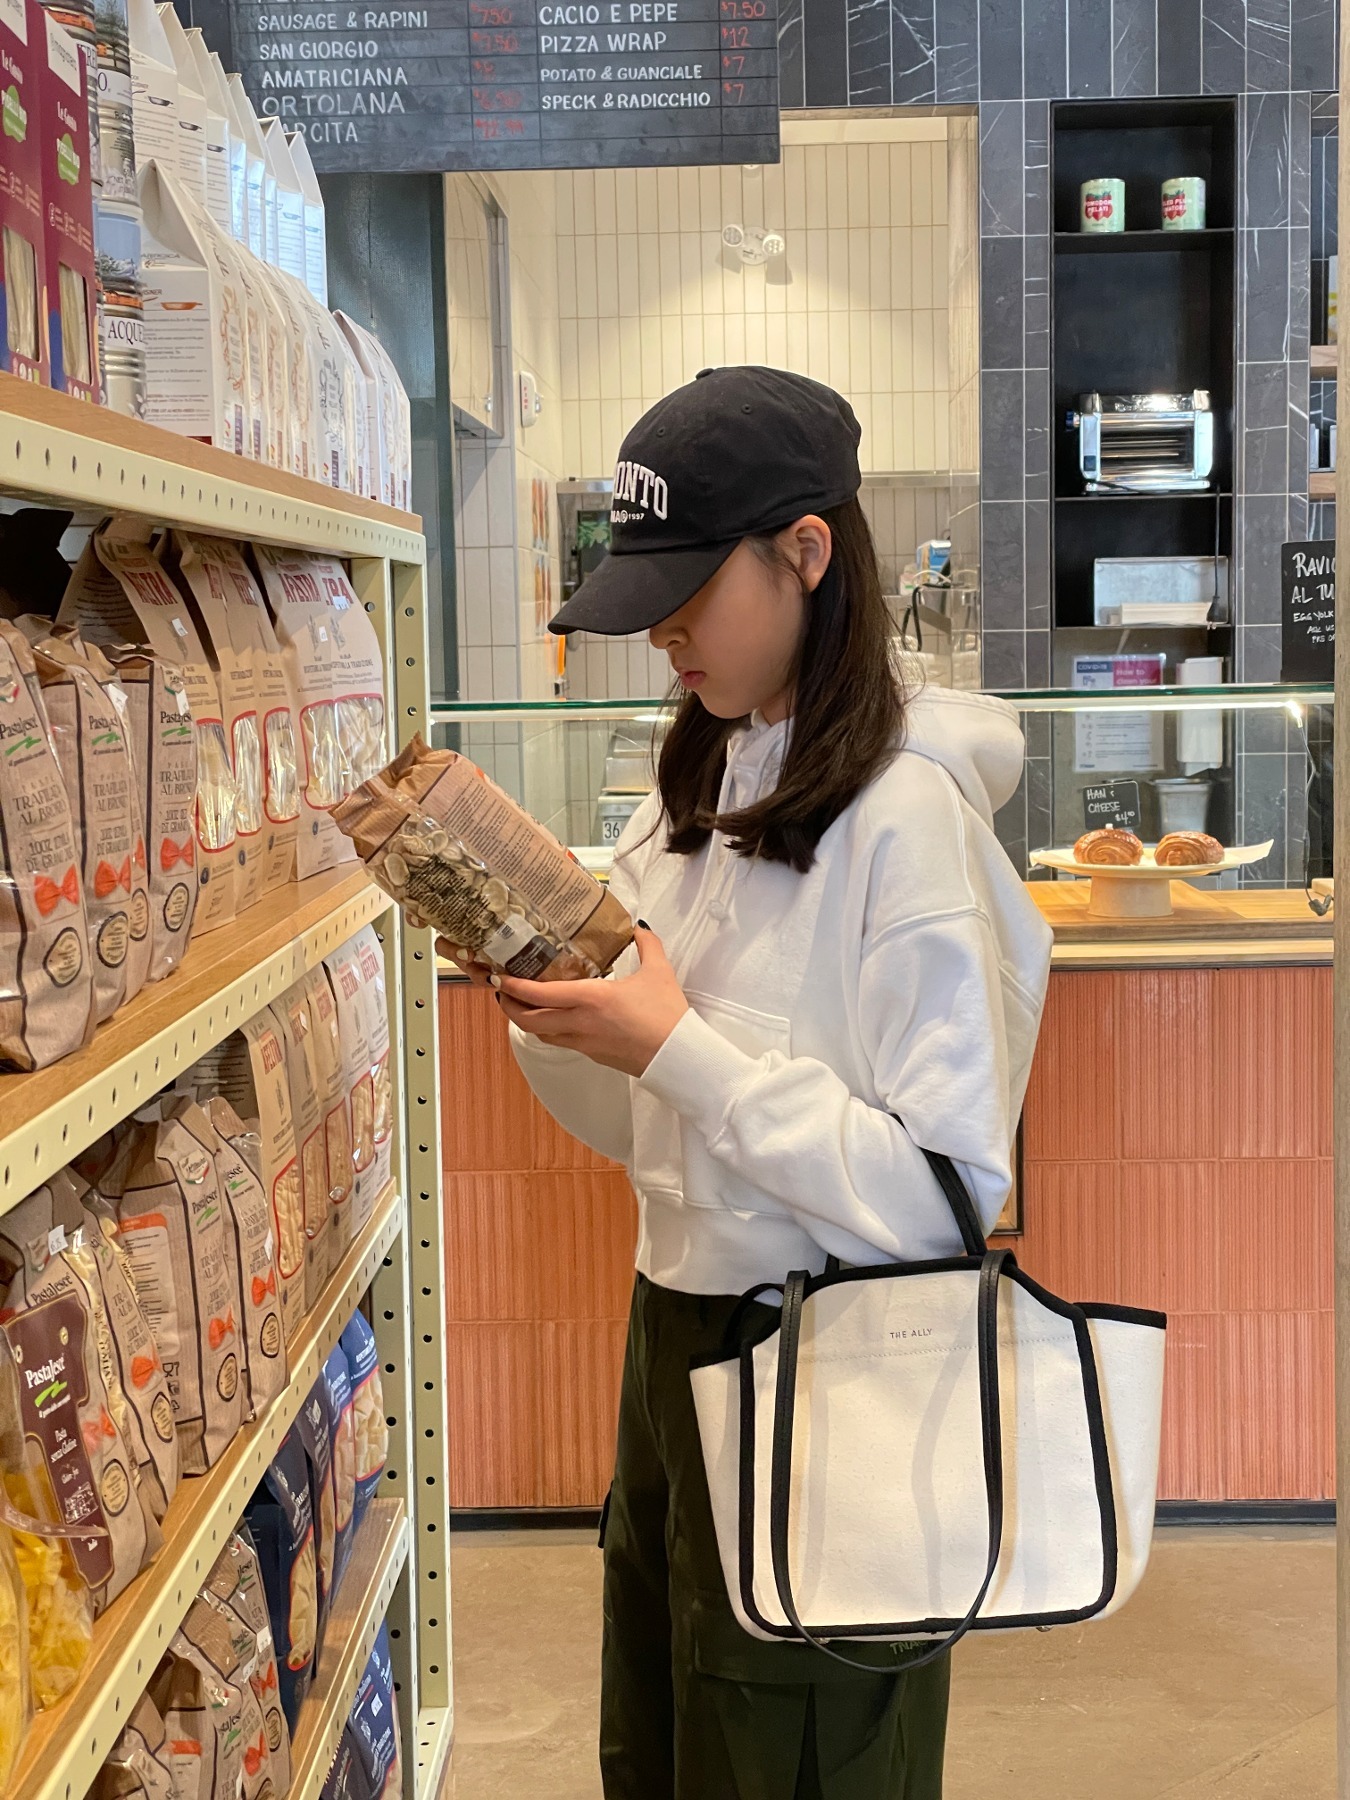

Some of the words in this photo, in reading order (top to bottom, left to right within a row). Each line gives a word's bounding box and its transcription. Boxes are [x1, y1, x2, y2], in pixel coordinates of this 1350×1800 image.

[258, 13, 337, 31] SAUSAGE
[346, 11, 358, 28] &
[365, 10, 428, 28] RAPINI
[539, 6, 600, 25] CACIO
[611, 4, 621, 22] E
[630, 3, 678, 23] PEPE
[541, 35, 599, 54] PIZZA
[608, 31, 667, 52] WRAP
[721, 26, 750, 49] $12
[259, 43, 294, 60] SAN
[299, 41, 378, 59] GIORGIO
[261, 67, 408, 89] AMATRICIANA
[540, 68, 595, 82] POTATO
[601, 66, 612, 80] &
[618, 64, 702, 80] GUANCIALE
[262, 91, 405, 116] ORTOLANA
[541, 94, 598, 110] SPECK
[603, 93, 615, 108] &
[617, 91, 711, 109] RADICCHIO
[1291, 585, 1313, 604] AL
[1293, 612, 1312, 622] EGG
[1313, 610, 1335, 621] YOLK
[1088, 801, 1120, 814] CHEESE
[604, 822, 620, 839] 36
[890, 1331, 907, 1339] THE
[911, 1328, 933, 1337] ALLY
